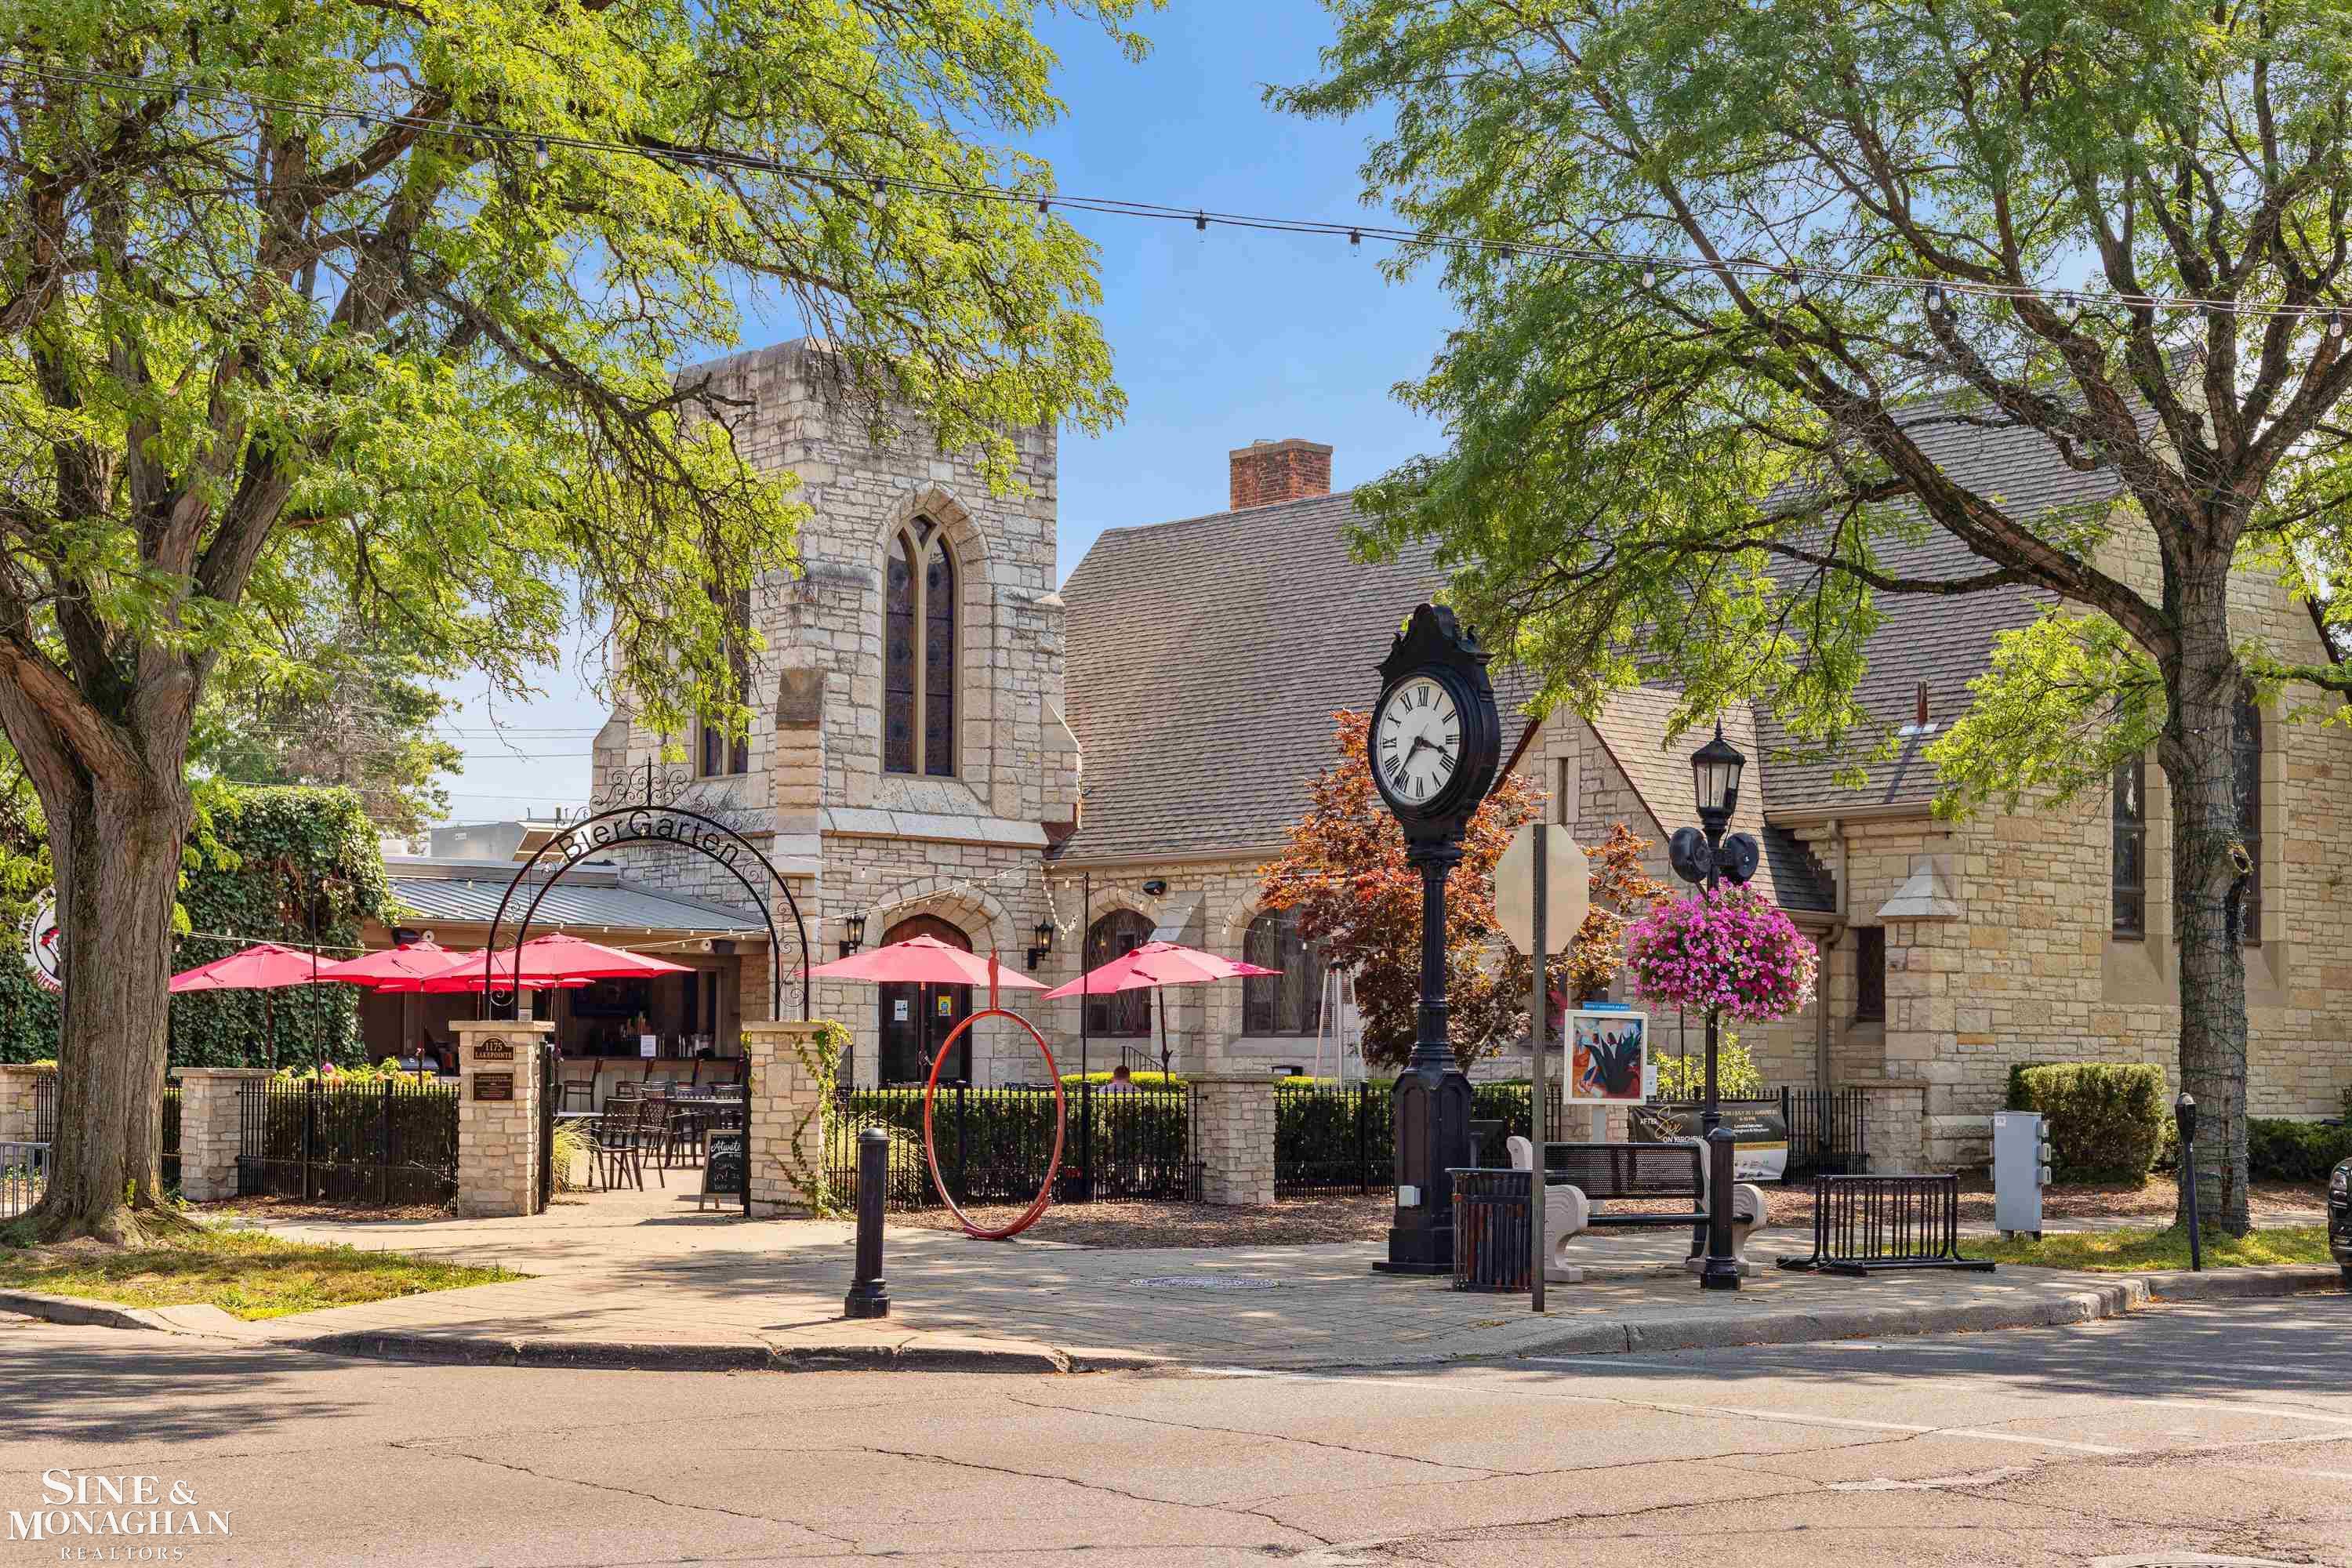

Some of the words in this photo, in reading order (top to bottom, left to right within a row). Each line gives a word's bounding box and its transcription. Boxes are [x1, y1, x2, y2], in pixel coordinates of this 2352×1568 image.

[557, 811, 739, 866] BierGarten
[485, 1042, 503, 1051] 1175
[710, 1140, 742, 1152] Atwate
